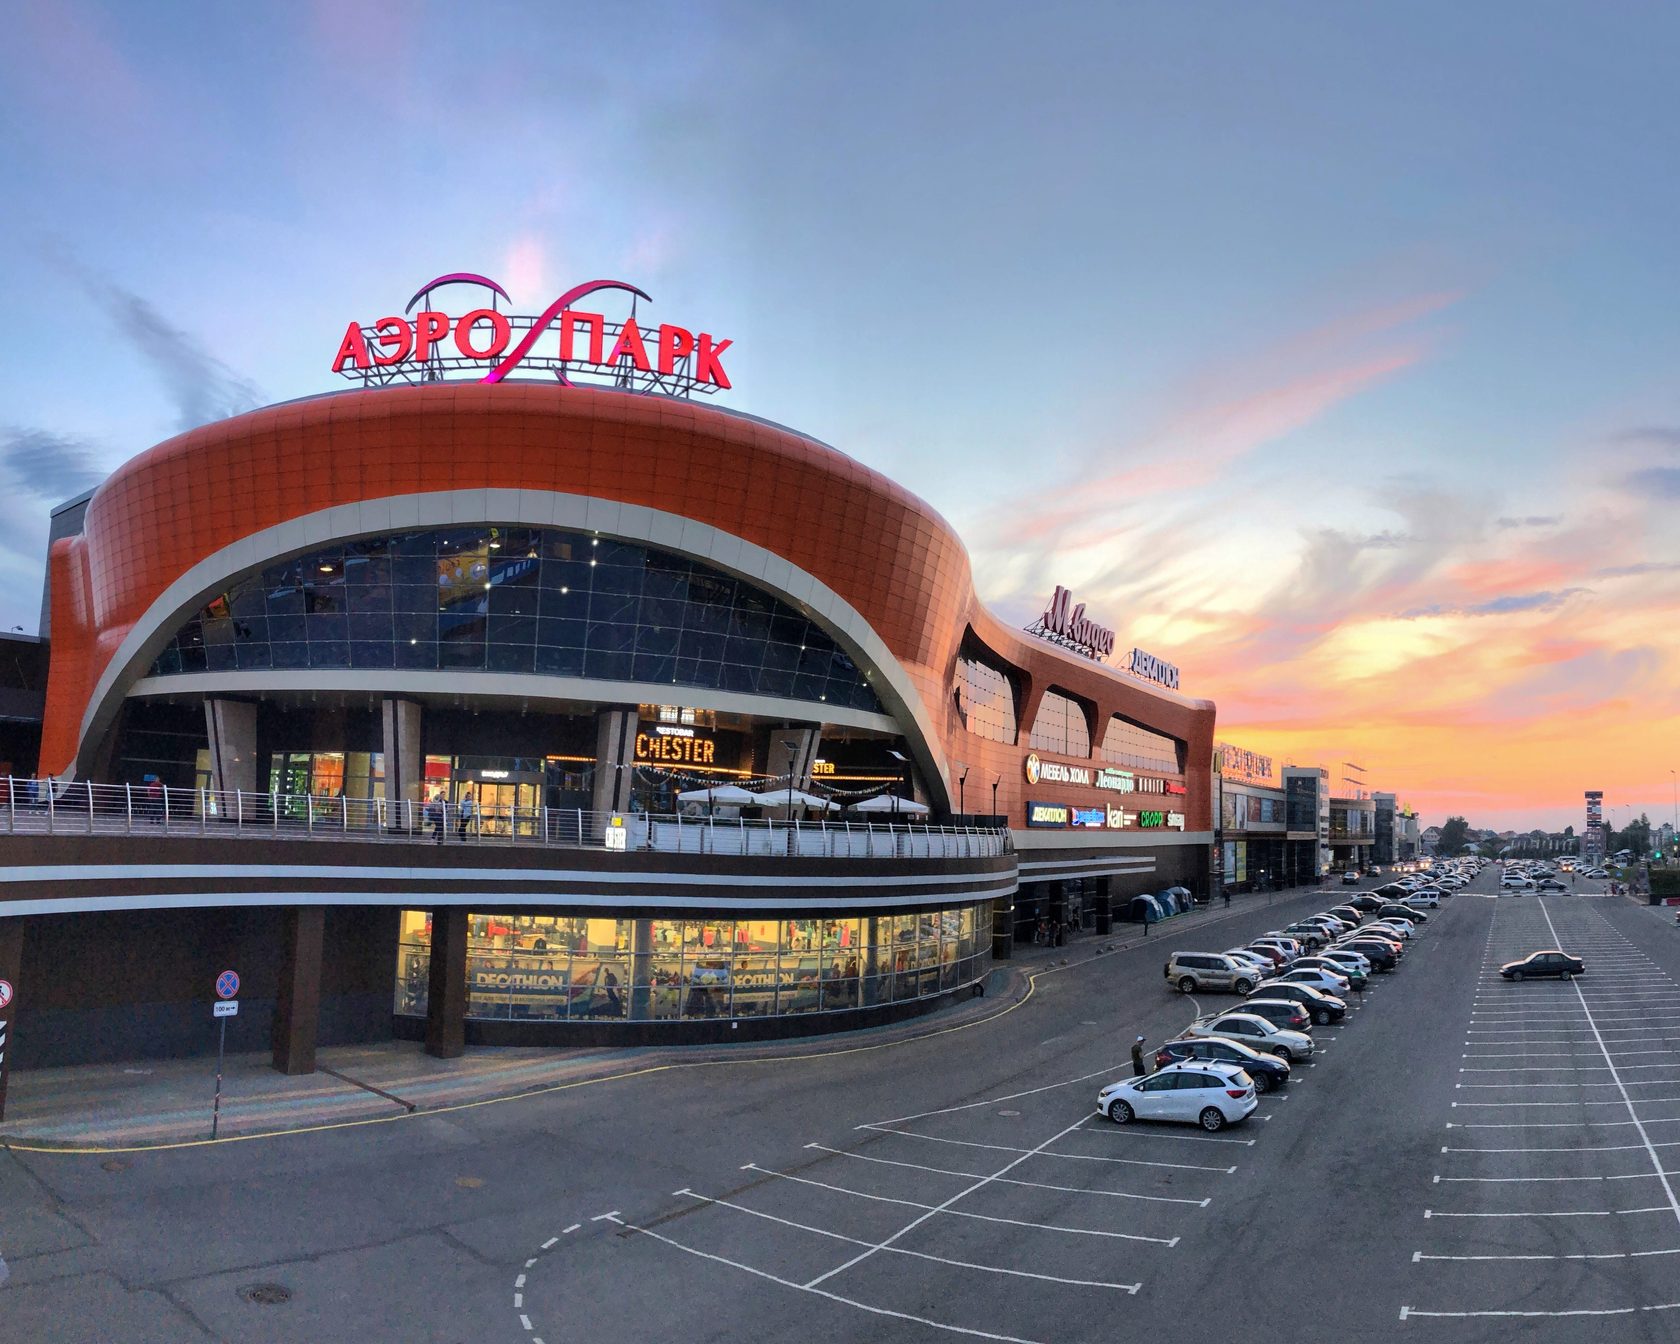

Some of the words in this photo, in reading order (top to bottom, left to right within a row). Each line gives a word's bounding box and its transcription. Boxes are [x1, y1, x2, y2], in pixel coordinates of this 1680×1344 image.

[332, 309, 511, 373] АЭРО
[559, 310, 733, 389] ПАРК
[1131, 648, 1179, 690] ДЕКАТЛОН
[636, 733, 715, 763] CHESTER
[1040, 763, 1070, 782] МЕБЕЛЬ
[1096, 770, 1135, 794] Леонардо
[1032, 806, 1067, 823] ДЕКАТЛОН
[1141, 811, 1163, 828] CROPP
[476, 973, 563, 990] DECATHLON
